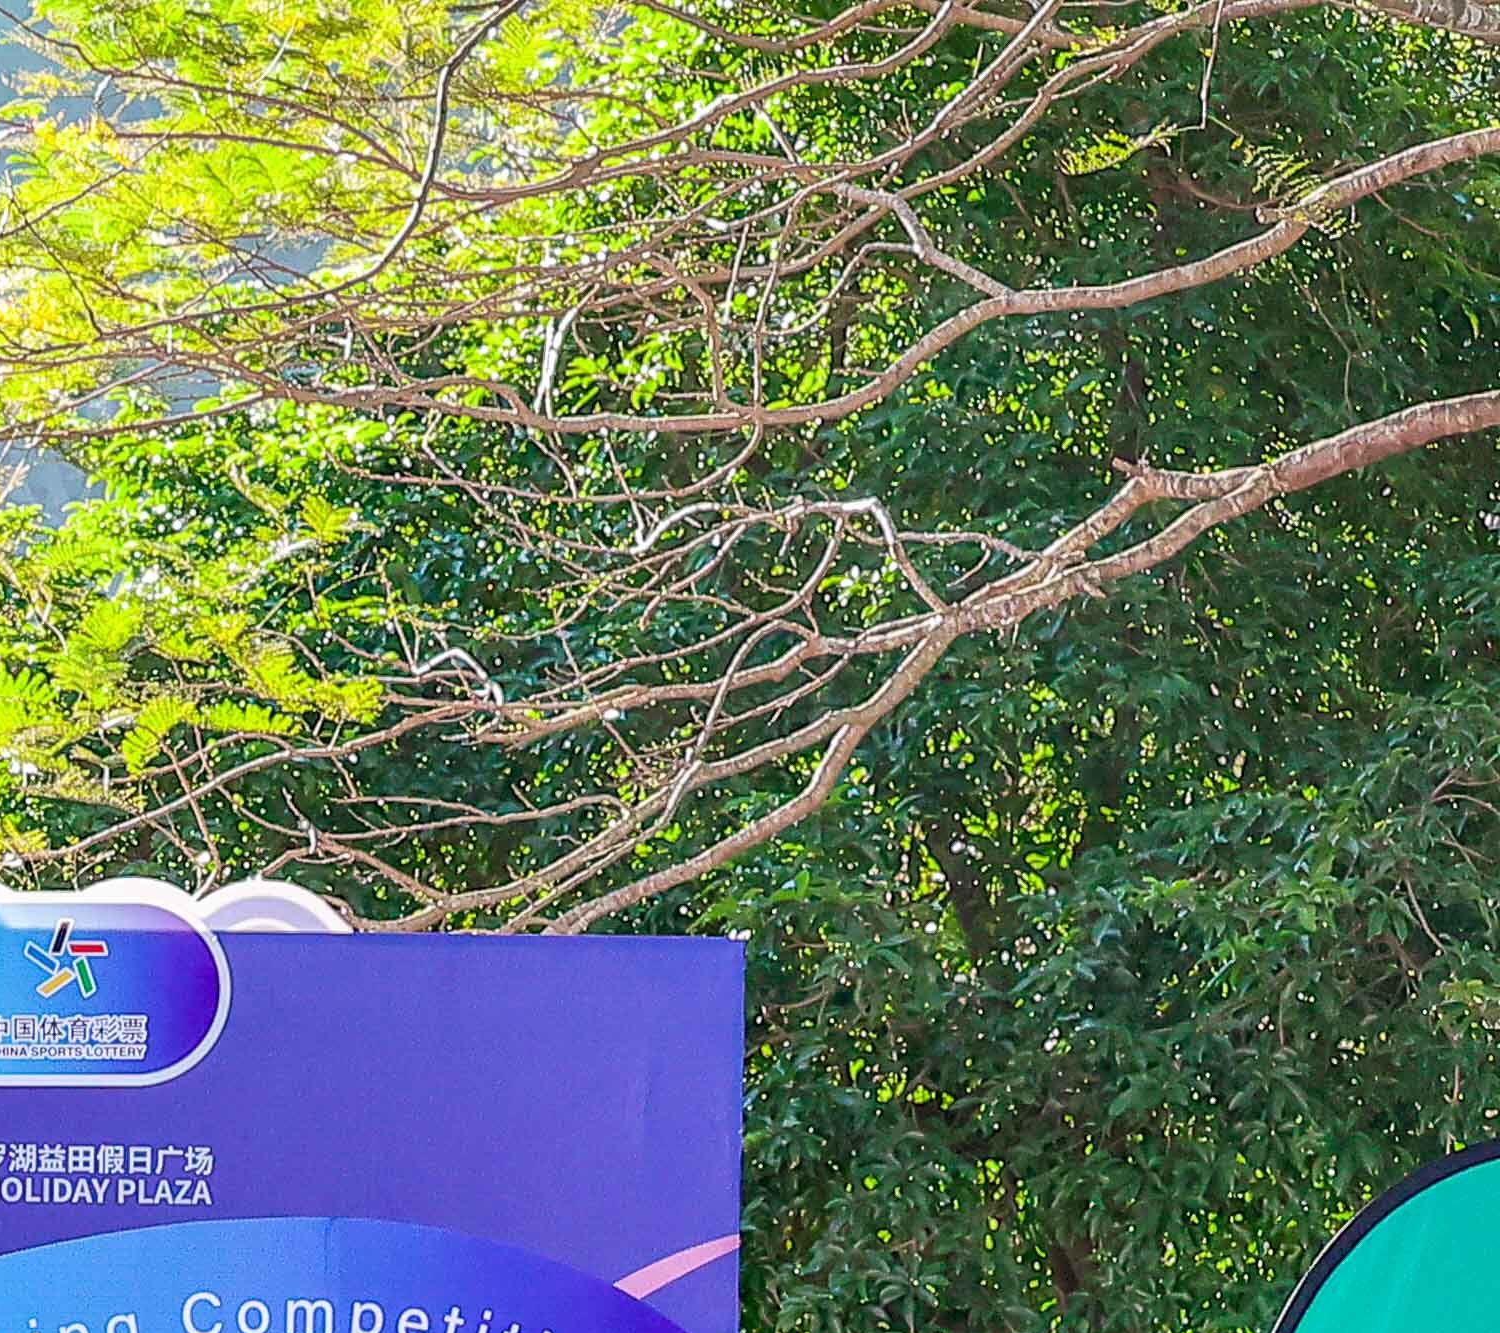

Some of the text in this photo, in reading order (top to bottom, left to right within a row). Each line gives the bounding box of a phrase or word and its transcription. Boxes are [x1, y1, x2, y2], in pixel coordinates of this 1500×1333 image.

[31, 1045, 83, 1058] SPORTS
[85, 1045, 145, 1058] LOTTERY
[118, 1177, 212, 1205] PLAZA
